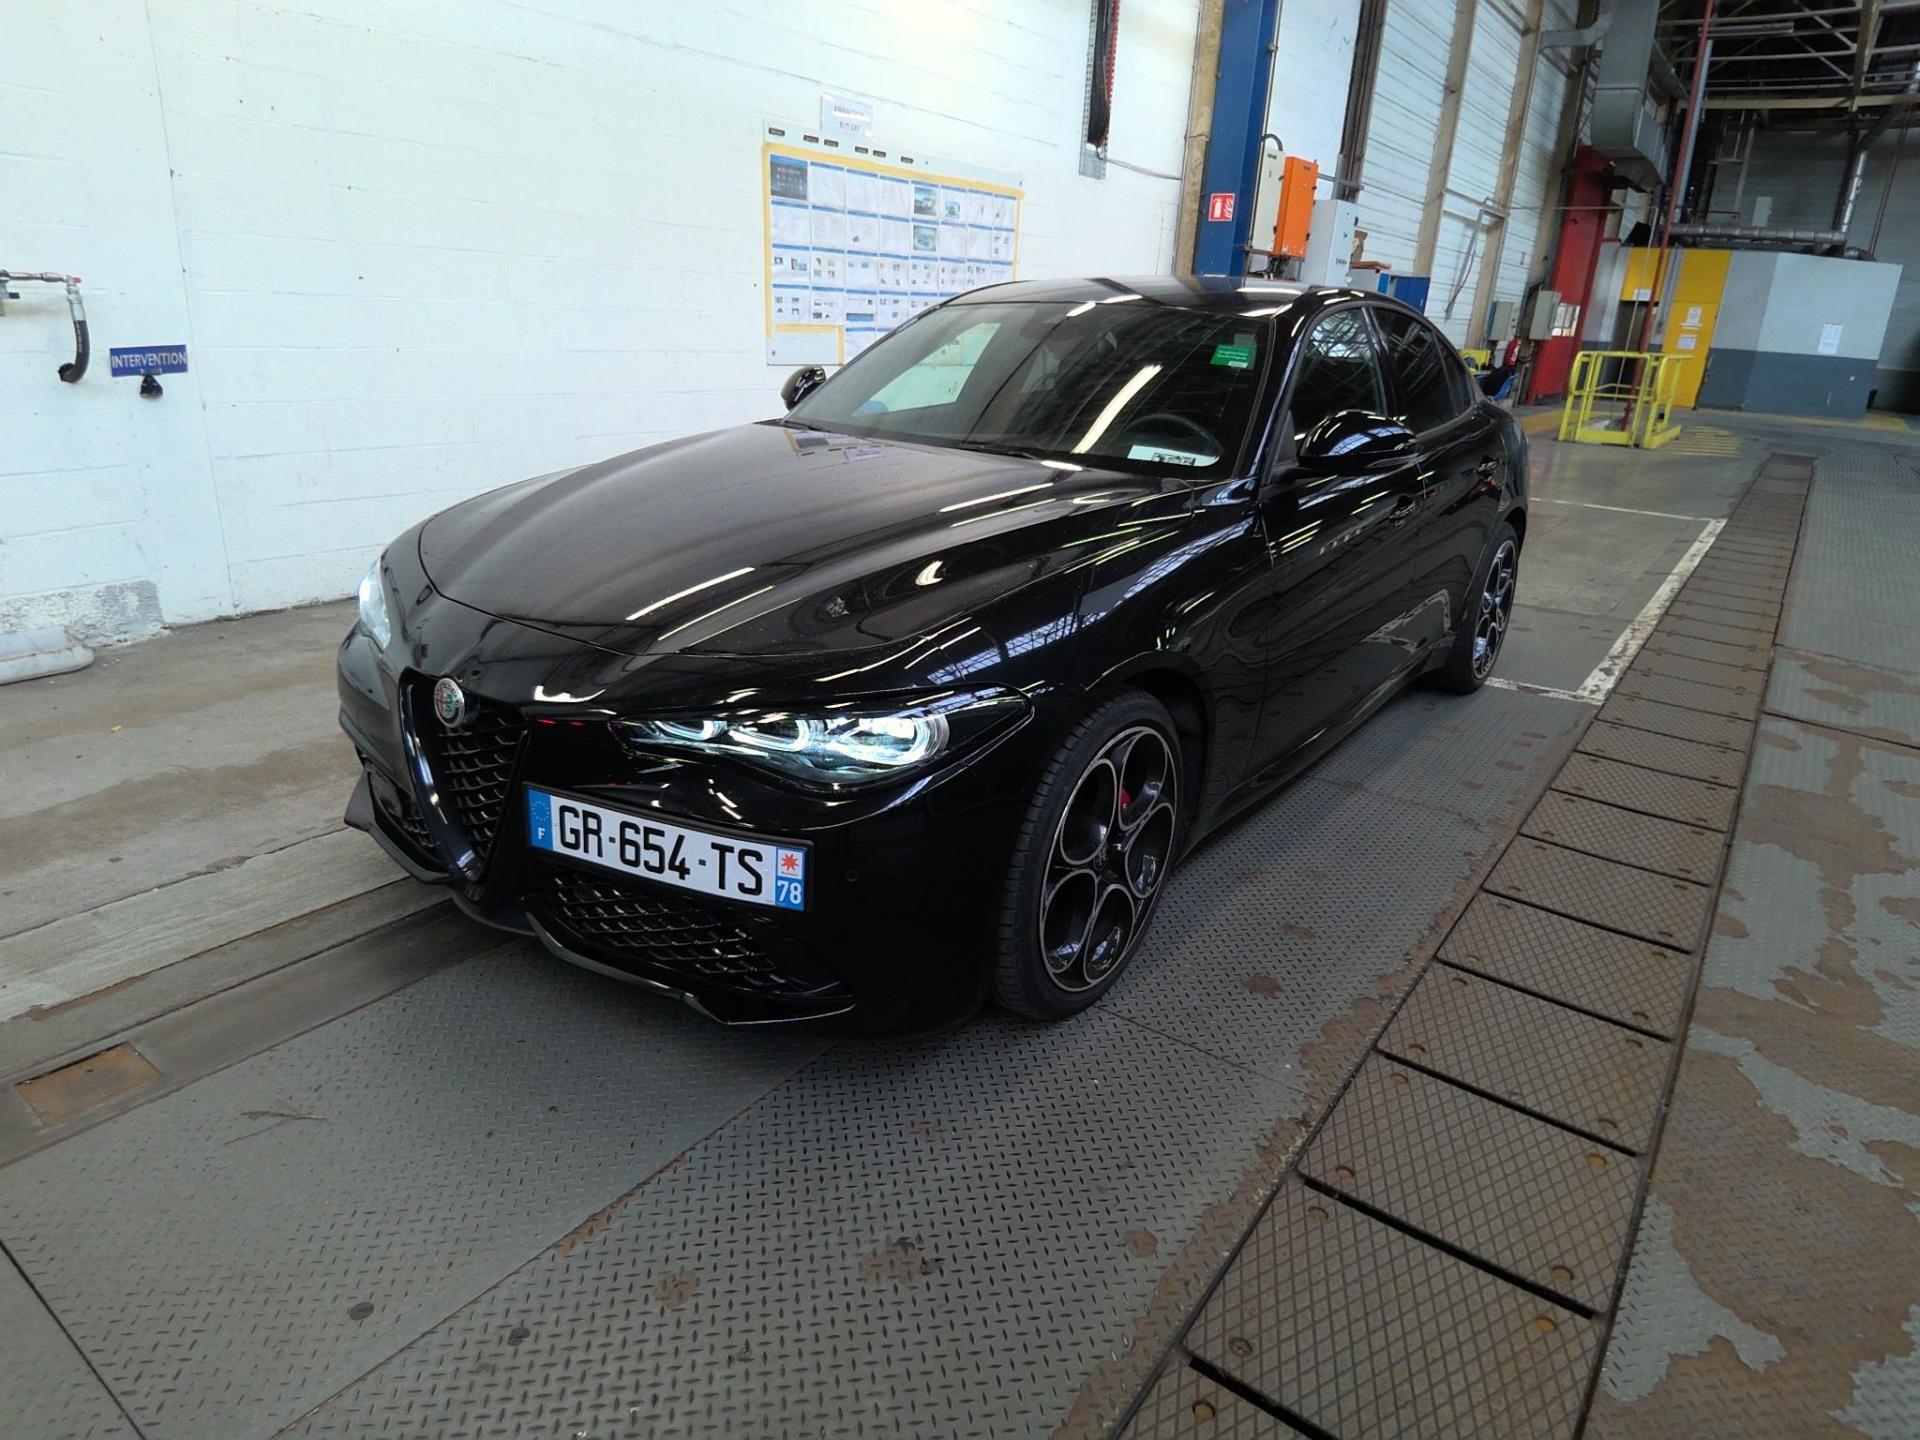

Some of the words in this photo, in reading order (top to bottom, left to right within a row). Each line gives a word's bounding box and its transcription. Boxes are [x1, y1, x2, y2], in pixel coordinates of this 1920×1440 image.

[111, 352, 187, 368] INTERVENTION
[537, 827, 545, 840] F
[558, 804, 763, 896] GR-654-TS
[777, 879, 802, 905] 78
